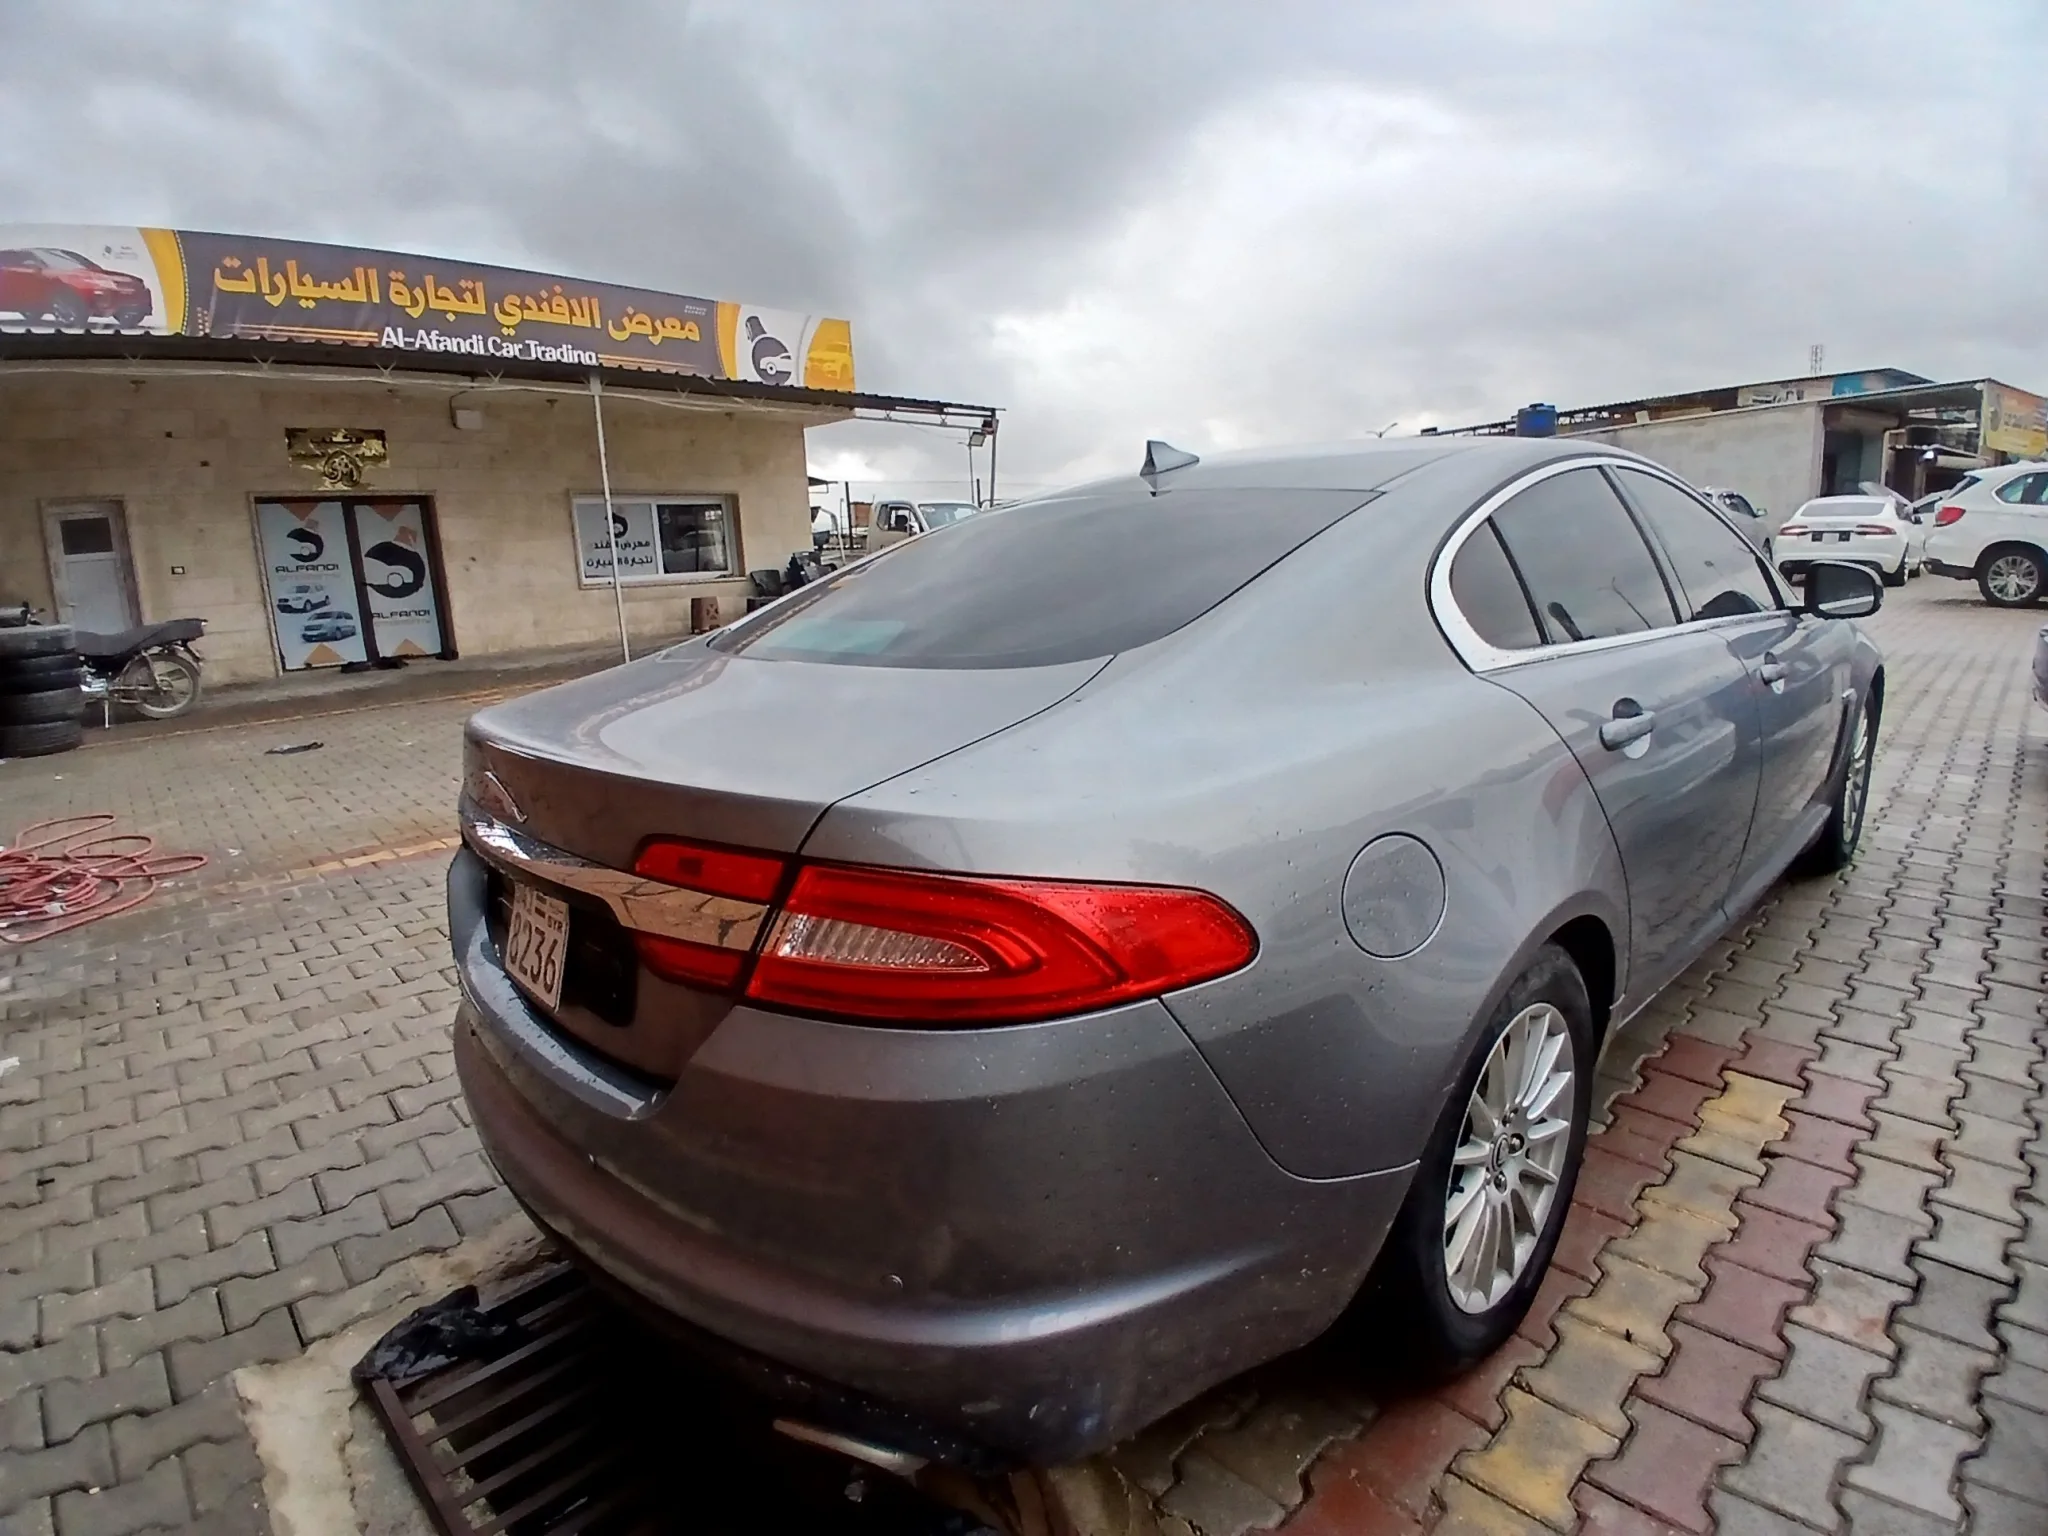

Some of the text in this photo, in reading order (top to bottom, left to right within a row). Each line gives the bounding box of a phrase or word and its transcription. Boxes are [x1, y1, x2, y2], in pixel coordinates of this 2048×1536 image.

[214, 256, 700, 346] معرض الافندي لتجارة السيارات
[381, 327, 485, 355] Al-Afandi
[488, 336, 523, 359] Car
[509, 912, 558, 995] 8236
